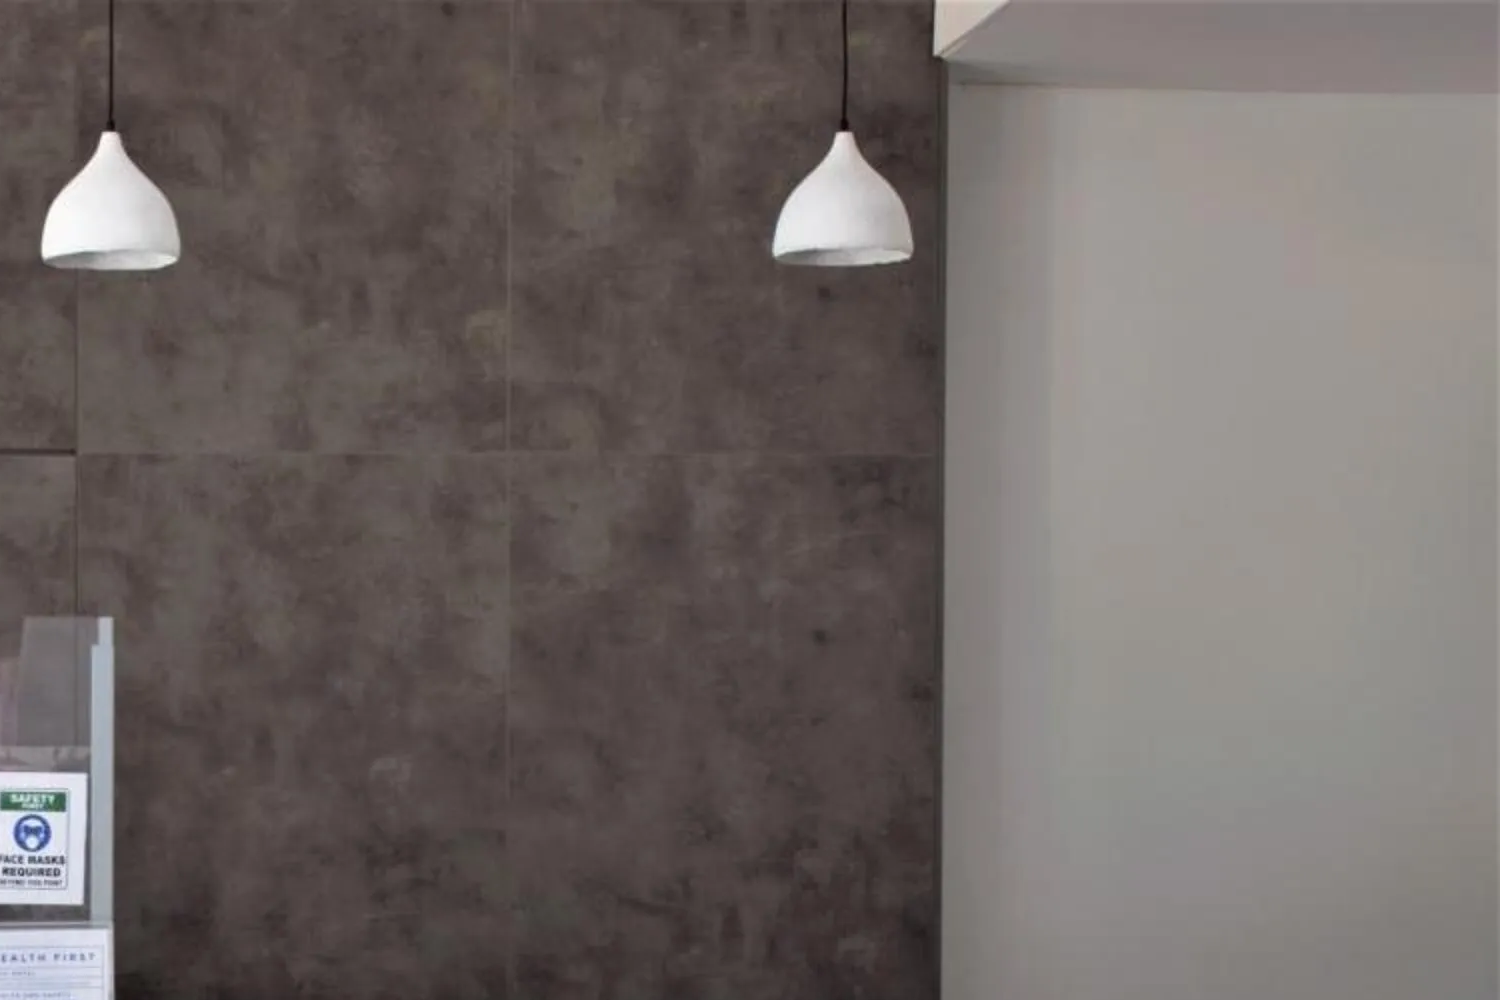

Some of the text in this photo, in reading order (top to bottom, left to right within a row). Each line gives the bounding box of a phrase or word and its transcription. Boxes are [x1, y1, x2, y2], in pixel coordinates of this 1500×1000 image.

[10, 793, 56, 804] SAFETY
[28, 855, 65, 865] MASKS
[2, 867, 61, 877] REQUIRED
[53, 952, 96, 962] FIRST
